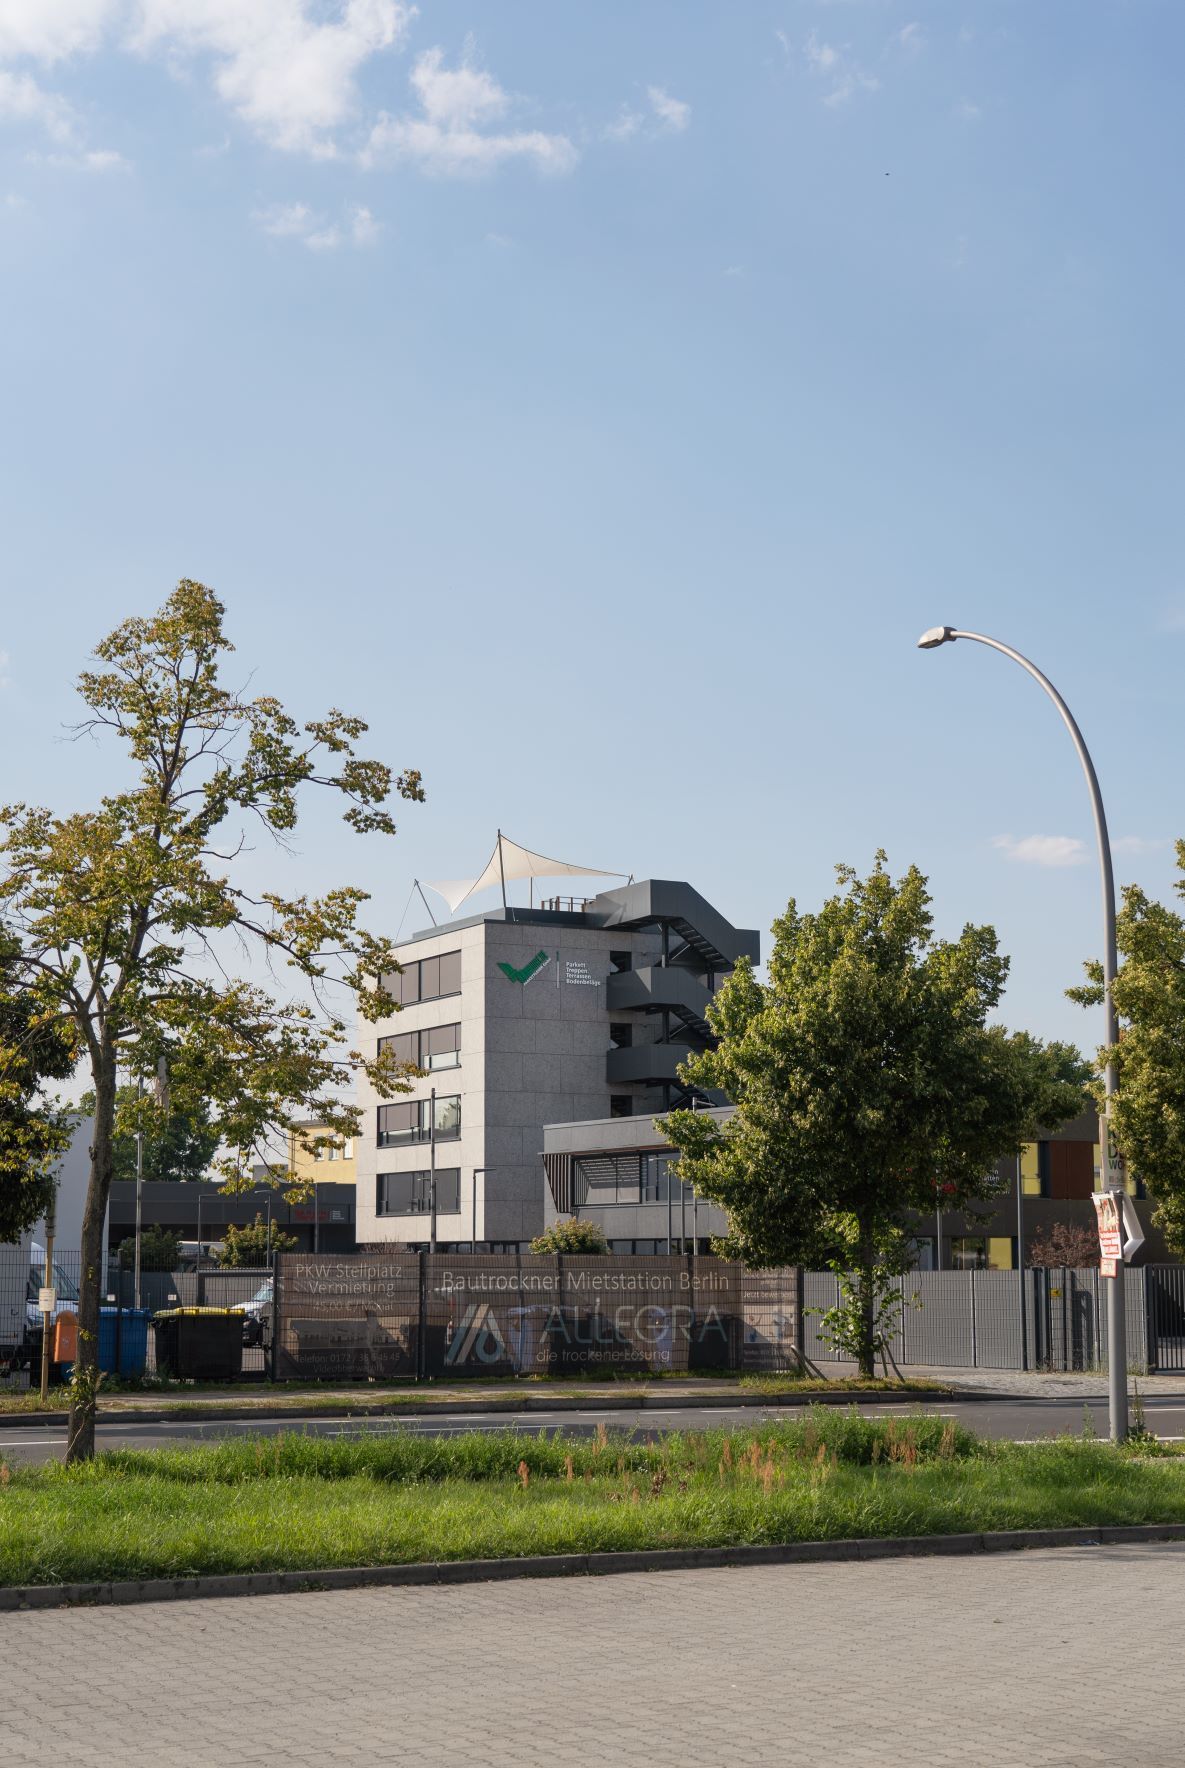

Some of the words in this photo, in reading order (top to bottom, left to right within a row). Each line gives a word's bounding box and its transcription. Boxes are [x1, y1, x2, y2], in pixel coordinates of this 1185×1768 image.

[296, 1264, 331, 1278] PKW
[336, 1263, 402, 1279] Stellplatz
[443, 1271, 560, 1290] Bautrockner
[567, 1271, 672, 1290] Mietstation
[680, 1271, 729, 1290] Berlin
[309, 1281, 394, 1297] Vermietung
[540, 1304, 728, 1344] ALLEGRA
[537, 1349, 558, 1362] die
[562, 1349, 619, 1361] trockene
